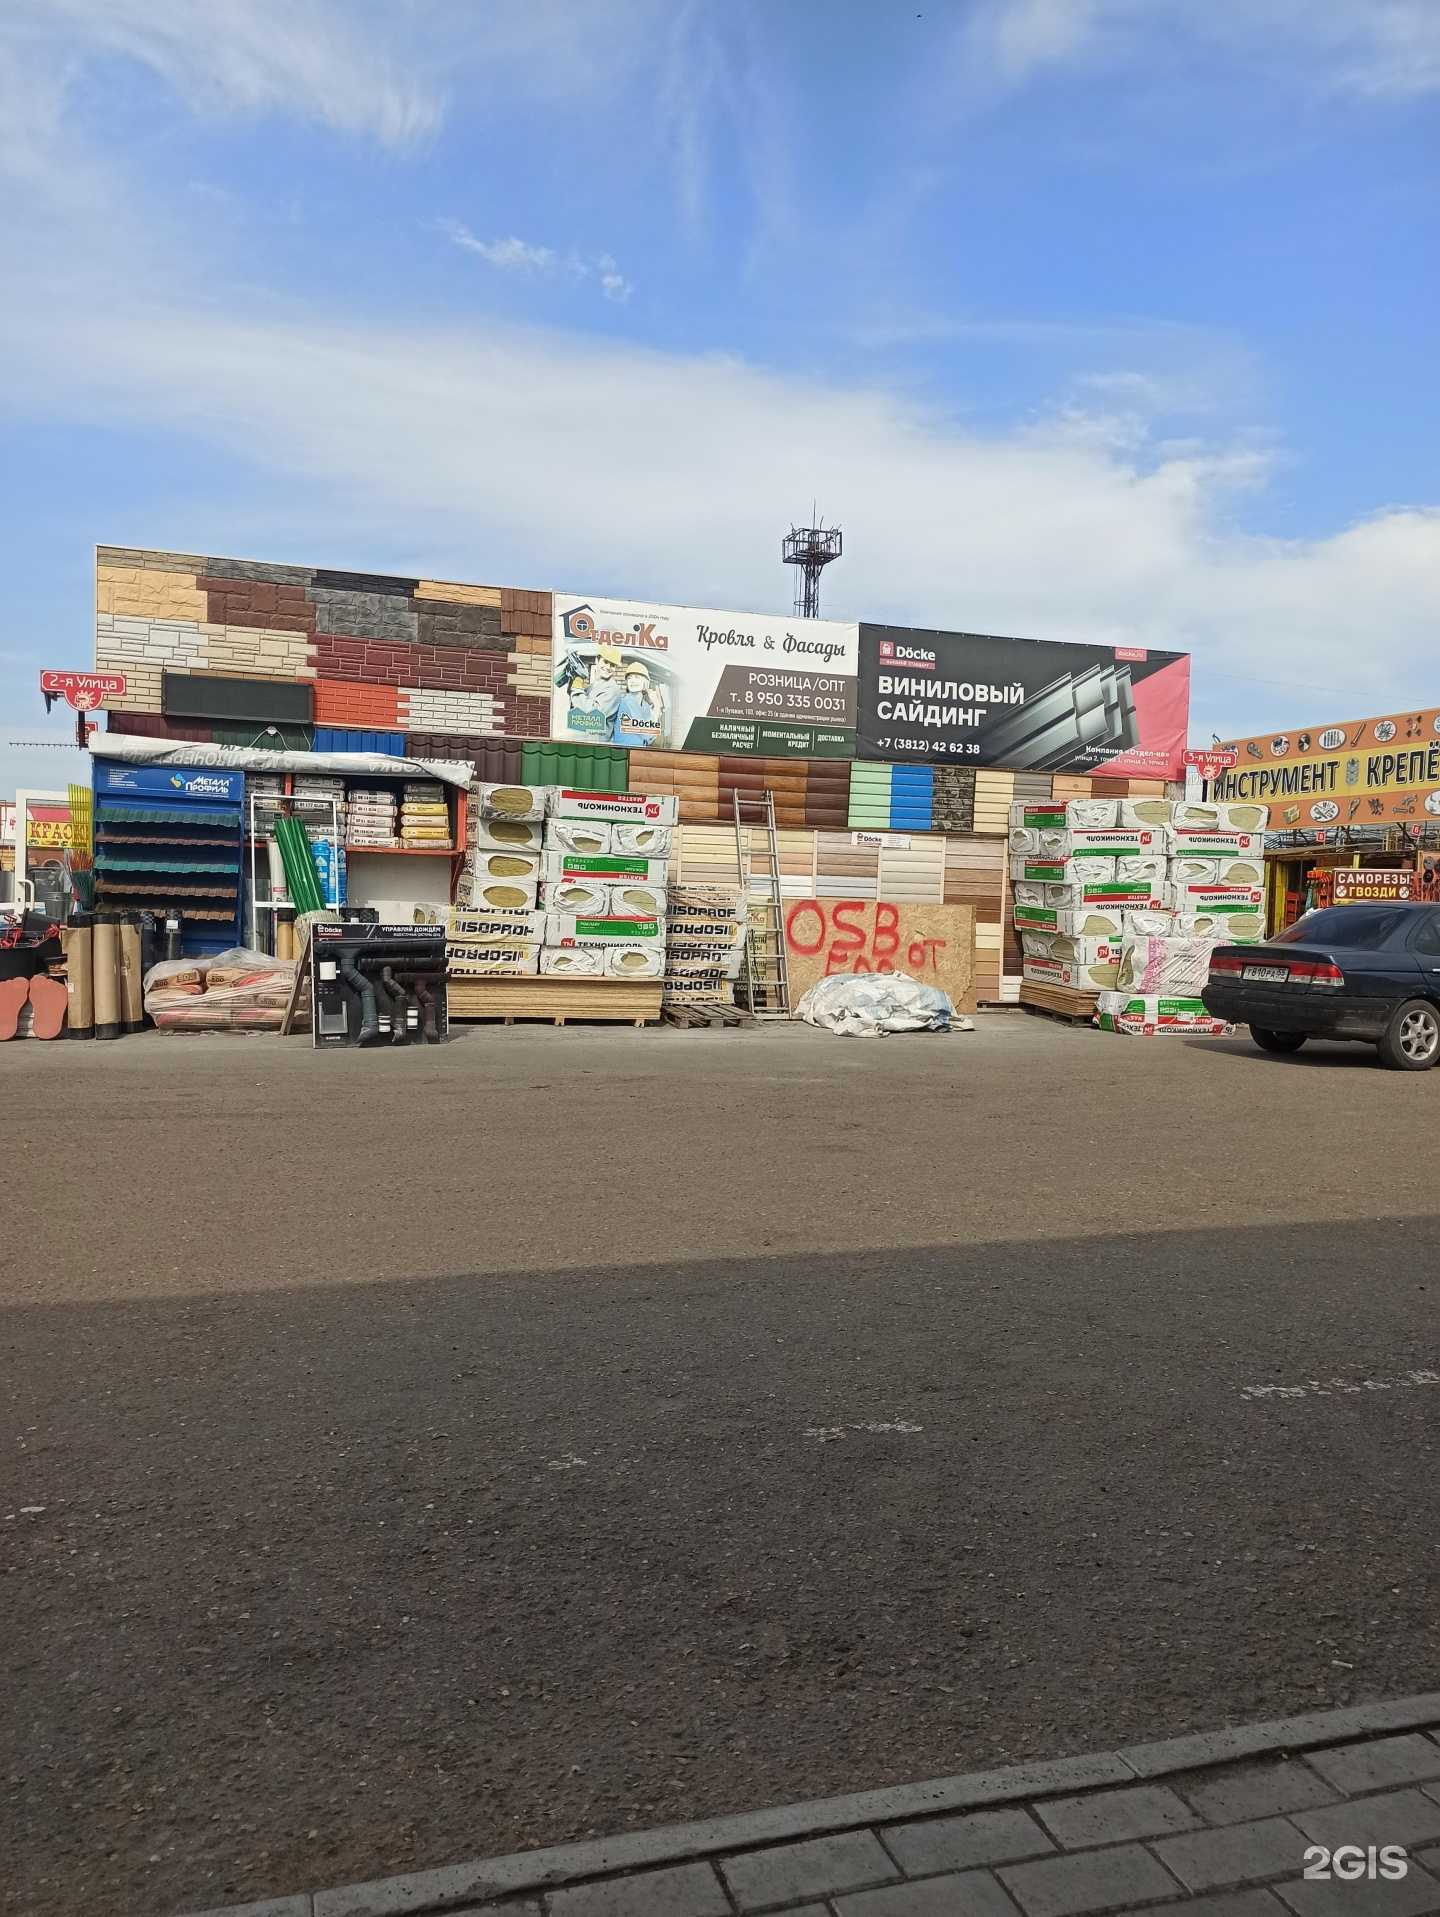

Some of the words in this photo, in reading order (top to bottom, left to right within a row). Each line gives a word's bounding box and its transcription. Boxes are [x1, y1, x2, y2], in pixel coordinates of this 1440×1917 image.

[696, 624, 756, 651] Кровля
[763, 635, 775, 650] &
[783, 632, 846, 662] Фасады
[896, 645, 936, 660] Döcke
[50, 674, 74, 687] 2-я
[77, 676, 118, 691] Улица
[748, 672, 846, 693] РОЗНИЦА/ОПТ
[878, 675, 1025, 704] ВИНИЛОВЫЙ
[745, 691, 754, 703] 8
[757, 692, 783, 706] 950
[786, 694, 811, 708] 335
[814, 696, 846, 710] 0031
[877, 699, 987, 728] САЙДИНГ
[631, 719, 661, 729] Döcke
[719, 724, 755, 733] НАЛИЧНЫЙ
[711, 731, 755, 741] БЕЗНАЛИЧНЫЙ
[762, 730, 810, 741] МОМЕНТАЛЬНЫЙ
[817, 734, 845, 743] ДОСТАВКА
[787, 740, 809, 749] КРЕДИТ
[877, 737, 891, 748] +7
[894, 738, 929, 753] (3812)
[932, 741, 947, 752] 42
[949, 742, 963, 753] 62
[965, 743, 980, 754] 38
[1086, 745, 1123, 755] Компания
[1188, 753, 1204, 763] 3-я
[1205, 753, 1232, 765] Улица
[1213, 760, 1341, 801] ИНСТРУМЕНТ
[577, 802, 644, 814] ТЕХНОНИКОЛЬ
[1188, 837, 1238, 845] ТЕХНОНИКОЛЬ
[1338, 873, 1410, 885] САМОРЕЗЫ
[1200, 894, 1249, 902] ТЕХНОНИКОЛЬ
[1349, 887, 1397, 898] ГВОЗДИ
[672, 905, 736, 917] ISOPROF
[1096, 903, 1148, 911] ТЕХНОНИКОЛЬ
[786, 899, 900, 958] OSB
